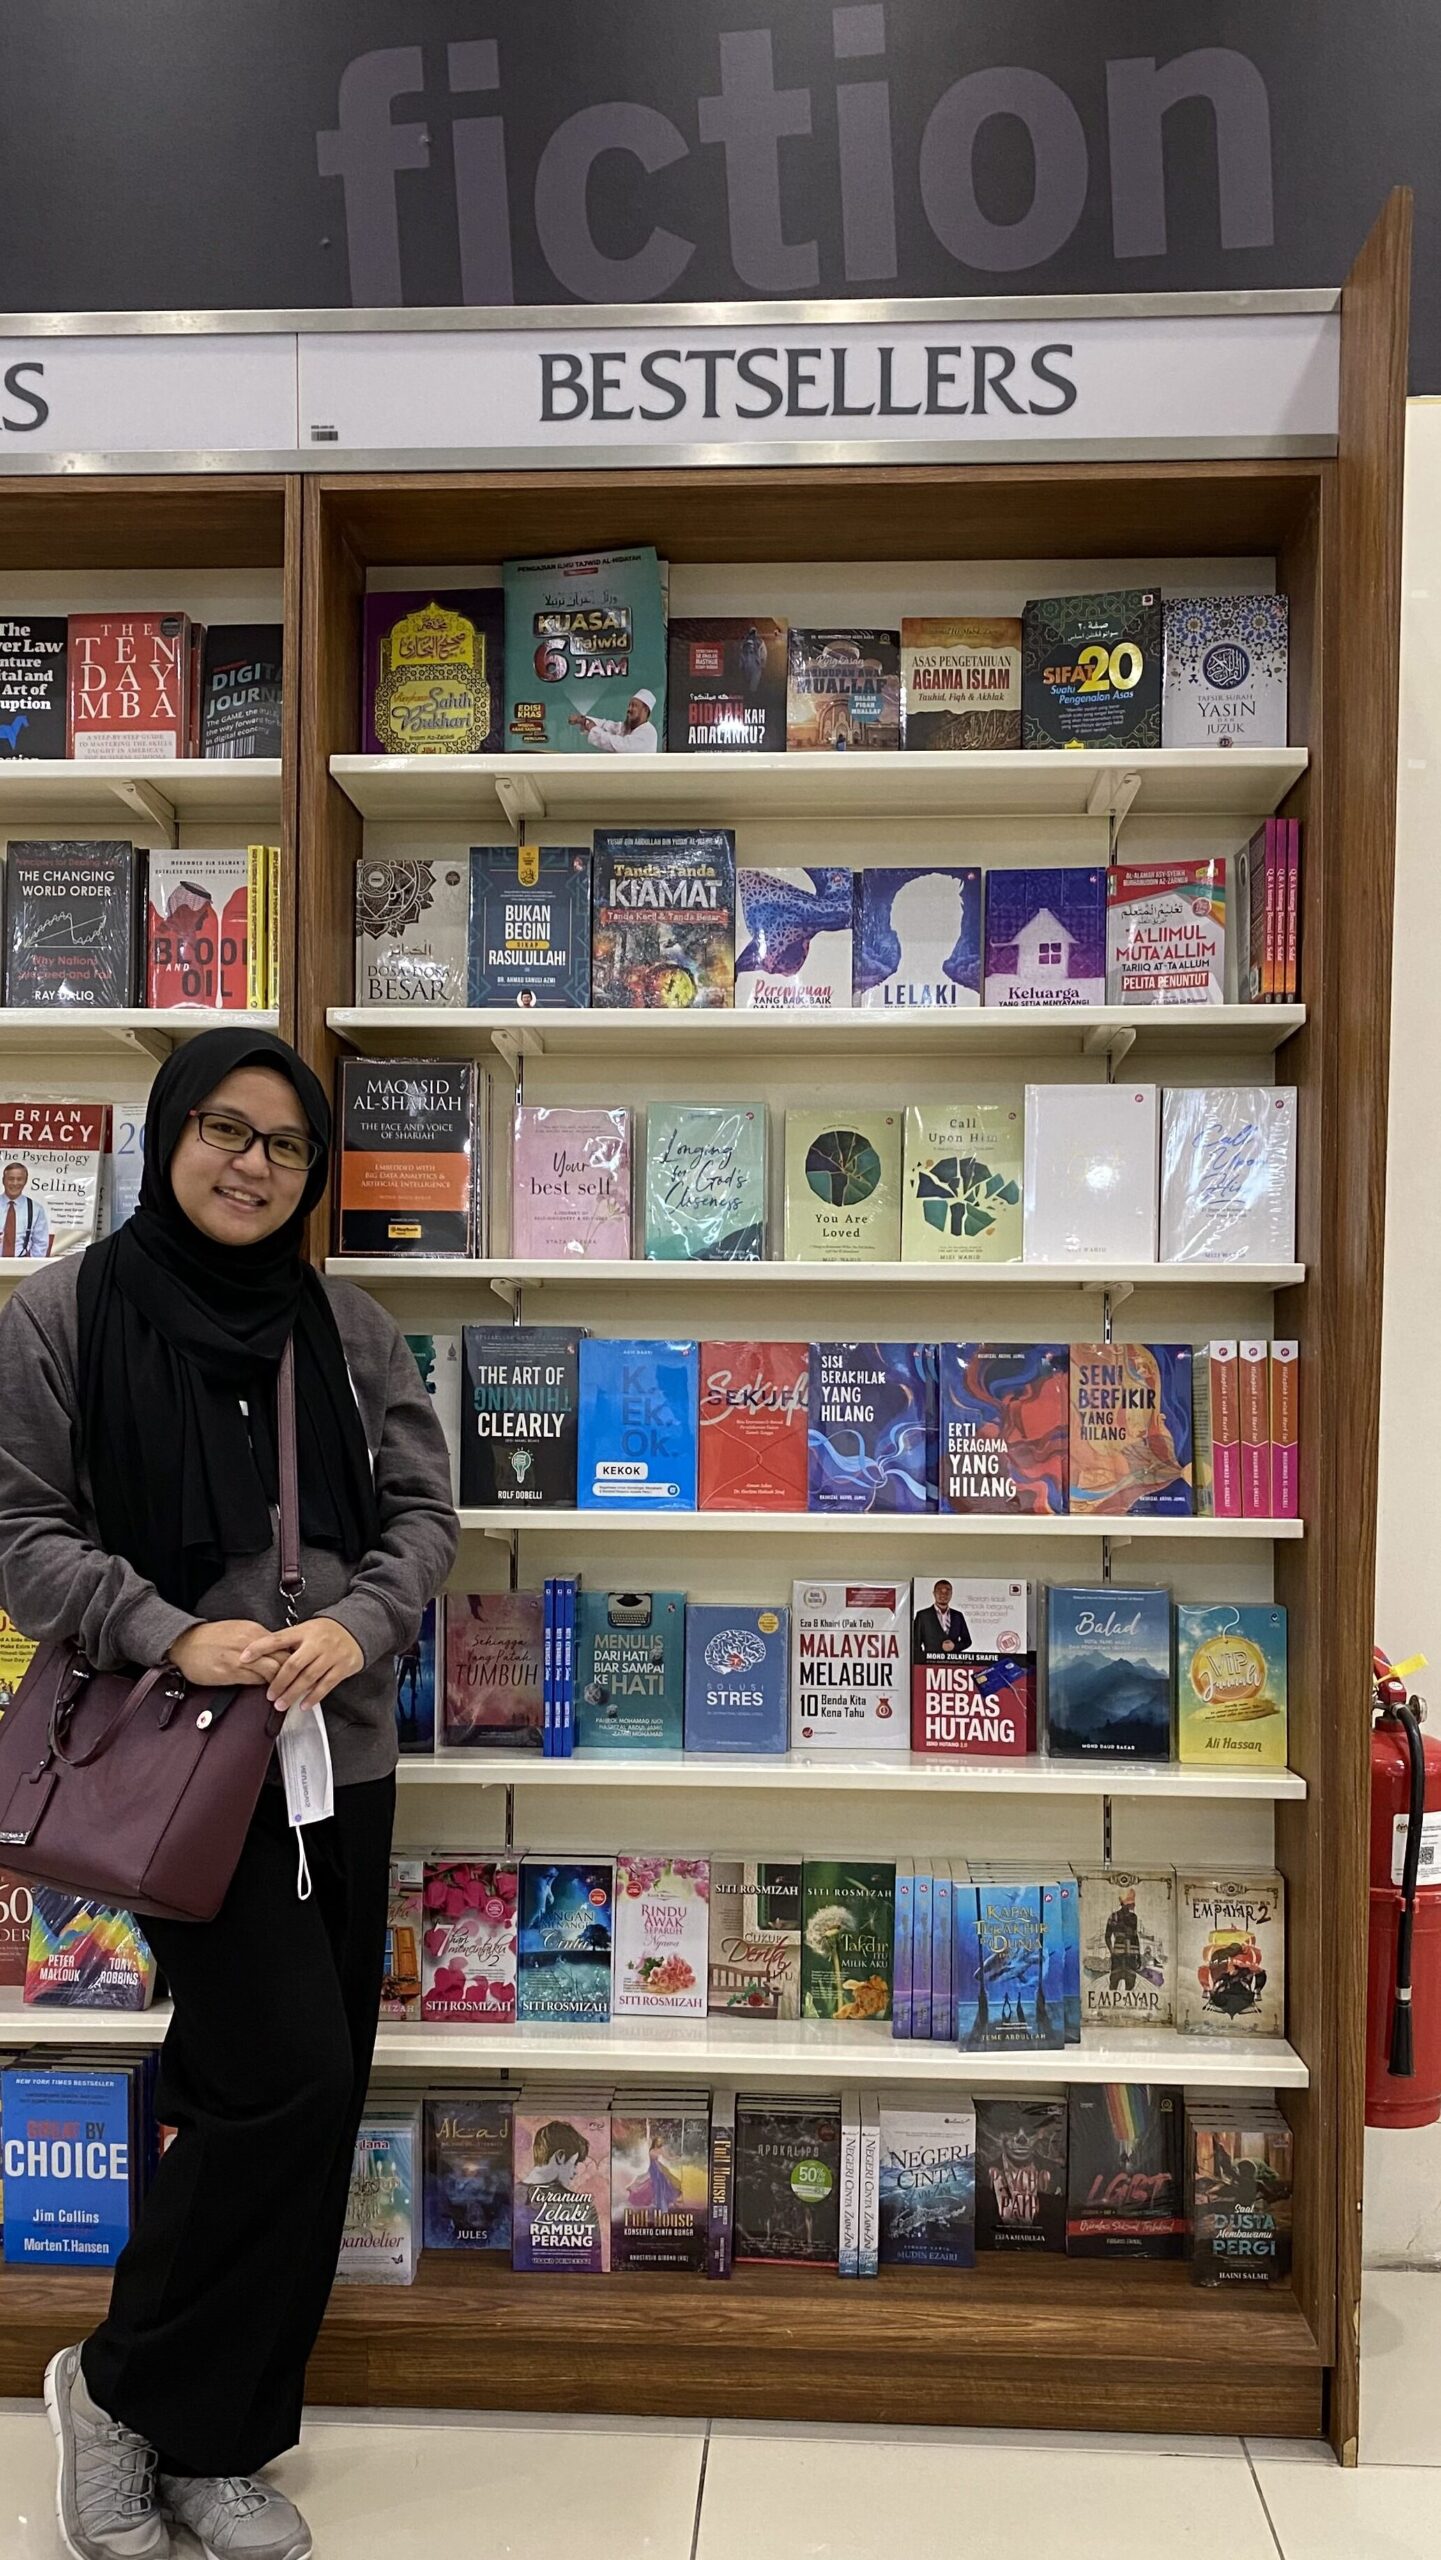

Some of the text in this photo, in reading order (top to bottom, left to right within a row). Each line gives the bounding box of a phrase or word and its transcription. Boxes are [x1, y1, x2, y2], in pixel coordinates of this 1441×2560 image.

[316, 2, 1274, 306] fiction
[538, 342, 1077, 423] BESTSELLERS
[538, 610, 626, 633] KUASAI
[101, 624, 153, 636] THE
[574, 633, 628, 652] Tajwid
[76, 637, 179, 664] TEN
[534, 638, 628, 682] 6 JAM
[912, 655, 1011, 668] ASAS PENGETAHUAN
[1043, 642, 1144, 692] SIFAT 20
[80, 664, 176, 692] DAY
[912, 668, 1010, 689] AGAMA ISLAM
[3, 684, 48, 695] Art of
[1050, 685, 1076, 695] Suatu
[1059, 690, 1134, 705] Pengenalan Asas
[79, 692, 176, 719] MBA
[1197, 700, 1255, 717] YASIN
[392, 704, 472, 735] Bukhari
[1206, 723, 1245, 735] JUZUK
[19, 871, 114, 882] THE CHANGING
[614, 864, 716, 877] Tanda-Tanda
[22, 886, 111, 896] WORLD ORDER
[609, 878, 723, 908] KIAMAT
[505, 905, 550, 922] BUKAN
[505, 922, 550, 940] BEGINI
[489, 951, 566, 966] RASULULLAH!
[165, 963, 190, 972] AND
[182, 970, 232, 997] OIL
[1123, 973, 1207, 990] PELITA PENUNTUT
[35, 990, 55, 1001] RAY
[368, 979, 451, 1001] BESAR
[884, 984, 956, 1004] LELAKI
[1008, 986, 1080, 1001] Keluarga
[753, 996, 831, 1004] YANG BAIK-BAIK
[366, 1079, 450, 1096] MAQASID
[353, 1096, 462, 1111] AL-SHARIAH
[15, 1109, 81, 1122] BRIAN
[360, 1122, 453, 1132] THE FACE AND VOICE
[949, 1118, 977, 1130] Call
[0, 1123, 94, 1142] TRACY
[380, 1132, 434, 1140] OF SHARIAH
[928, 1132, 998, 1145] Upon Him
[56, 1164, 69, 1174] of
[30, 1178, 86, 1196] Selling
[530, 1176, 612, 1196] best self
[815, 1214, 868, 1224] You Are
[822, 1227, 860, 1238] Loved
[821, 1355, 843, 1369] SISI
[479, 1366, 564, 1385] THE ART OF
[821, 1371, 886, 1384] BERAKHLAK
[1079, 1364, 1124, 1386] SENI
[821, 1387, 861, 1402] YANG
[1078, 1388, 1156, 1410] BERFIKIR
[821, 1406, 874, 1422] HILANG
[1079, 1411, 1113, 1425] YANG
[477, 1413, 565, 1438] CLEARLY
[948, 1422, 976, 1437] ERTI
[1080, 1426, 1127, 1441] HILANG
[948, 1438, 1008, 1452] BERAGAMA
[602, 1466, 641, 1475] KEKOK
[949, 1455, 999, 1475] YANG
[498, 1491, 542, 1499] ROLF DOBELLI
[949, 1477, 1017, 1498] HILANG
[1075, 1611, 1142, 1637] Balad
[594, 1634, 664, 1649] MENULIS
[800, 1634, 899, 1658] MALAYSIA
[594, 1650, 648, 1661] DARI HATI
[926, 1653, 945, 1661] MOHD
[947, 1653, 974, 1661] ZULKIFLI
[456, 1663, 538, 1687] TUMBUH
[594, 1664, 664, 1673] BIAR SAMPAI
[800, 1662, 893, 1686] MELABUR
[594, 1674, 664, 1696] KE HATI
[706, 1692, 764, 1706] STRES
[800, 1695, 867, 1717] 10 Benda Kita
[925, 1693, 1000, 1717] BEBAS
[821, 1707, 865, 1718] Kena Tahu
[925, 1718, 1015, 1743] HUTANG
[1205, 1736, 1262, 1752] Ali Hassan
[715, 1883, 799, 1896] SITI ROSMIZAH
[808, 1888, 892, 1898] SITI ROSMIZAH
[641, 1904, 687, 1918] RINDU
[1193, 1904, 1271, 1924] EMPAYAR 2
[644, 1917, 684, 1928] AWAK
[644, 1927, 682, 1935] SEPARUH
[744, 1932, 782, 1943] CUKUP
[48, 1955, 75, 1966] PETER
[488, 1955, 500, 1967] 2
[842, 1959, 888, 1968] MILIK AKU
[40, 1968, 80, 1981] MALLOUK
[426, 2001, 511, 2011] SITI ROSMIZAH
[523, 2001, 607, 2012] SITI ROSMIZAH
[619, 1995, 702, 2008] SITI ROSMIZAH
[1088, 1990, 1163, 2011] EMPAYAR
[73, 2079, 114, 2087] BESTSELLER
[4, 2140, 128, 2180] CHOICE
[889, 2144, 970, 2169] NEGERI
[897, 2167, 958, 2189] CINTA
[33, 2209, 100, 2223] Jim Collins
[1234, 2203, 1255, 2214] Saat
[1214, 2214, 1276, 2230] DUSTA
[457, 2230, 488, 2240] JULES
[530, 2224, 595, 2236] RAMBUT
[1216, 2229, 1272, 2239] Membawamu
[24, 2238, 109, 2253] Morten T. Hansen
[532, 2235, 593, 2247] PERANG
[1213, 2240, 1276, 2255] PERGI
